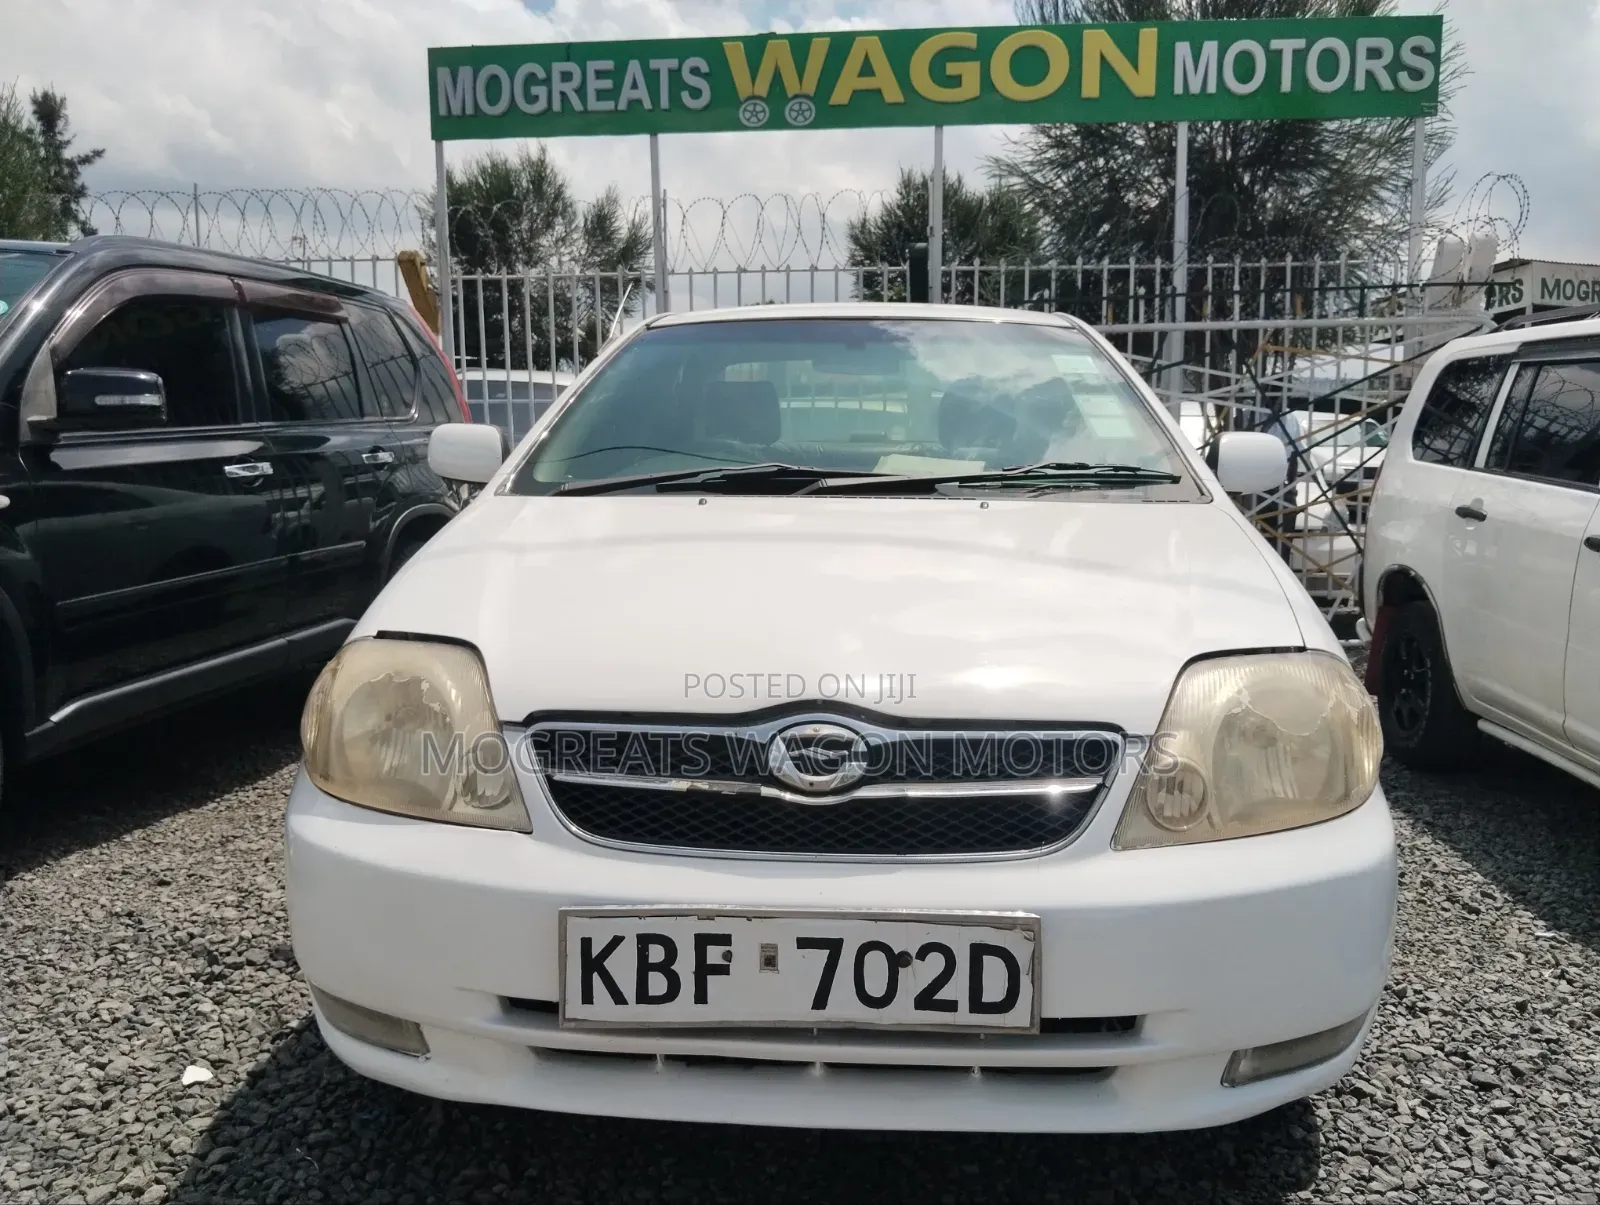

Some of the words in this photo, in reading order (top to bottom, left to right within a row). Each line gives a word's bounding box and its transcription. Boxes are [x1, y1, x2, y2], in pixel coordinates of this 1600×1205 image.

[436, 57, 711, 117] MOGREATS
[723, 28, 1158, 107] WAGON
[1173, 35, 1435, 96] MOTORS
[580, 933, 732, 1005] KBF
[796, 937, 1021, 1014] 702D
